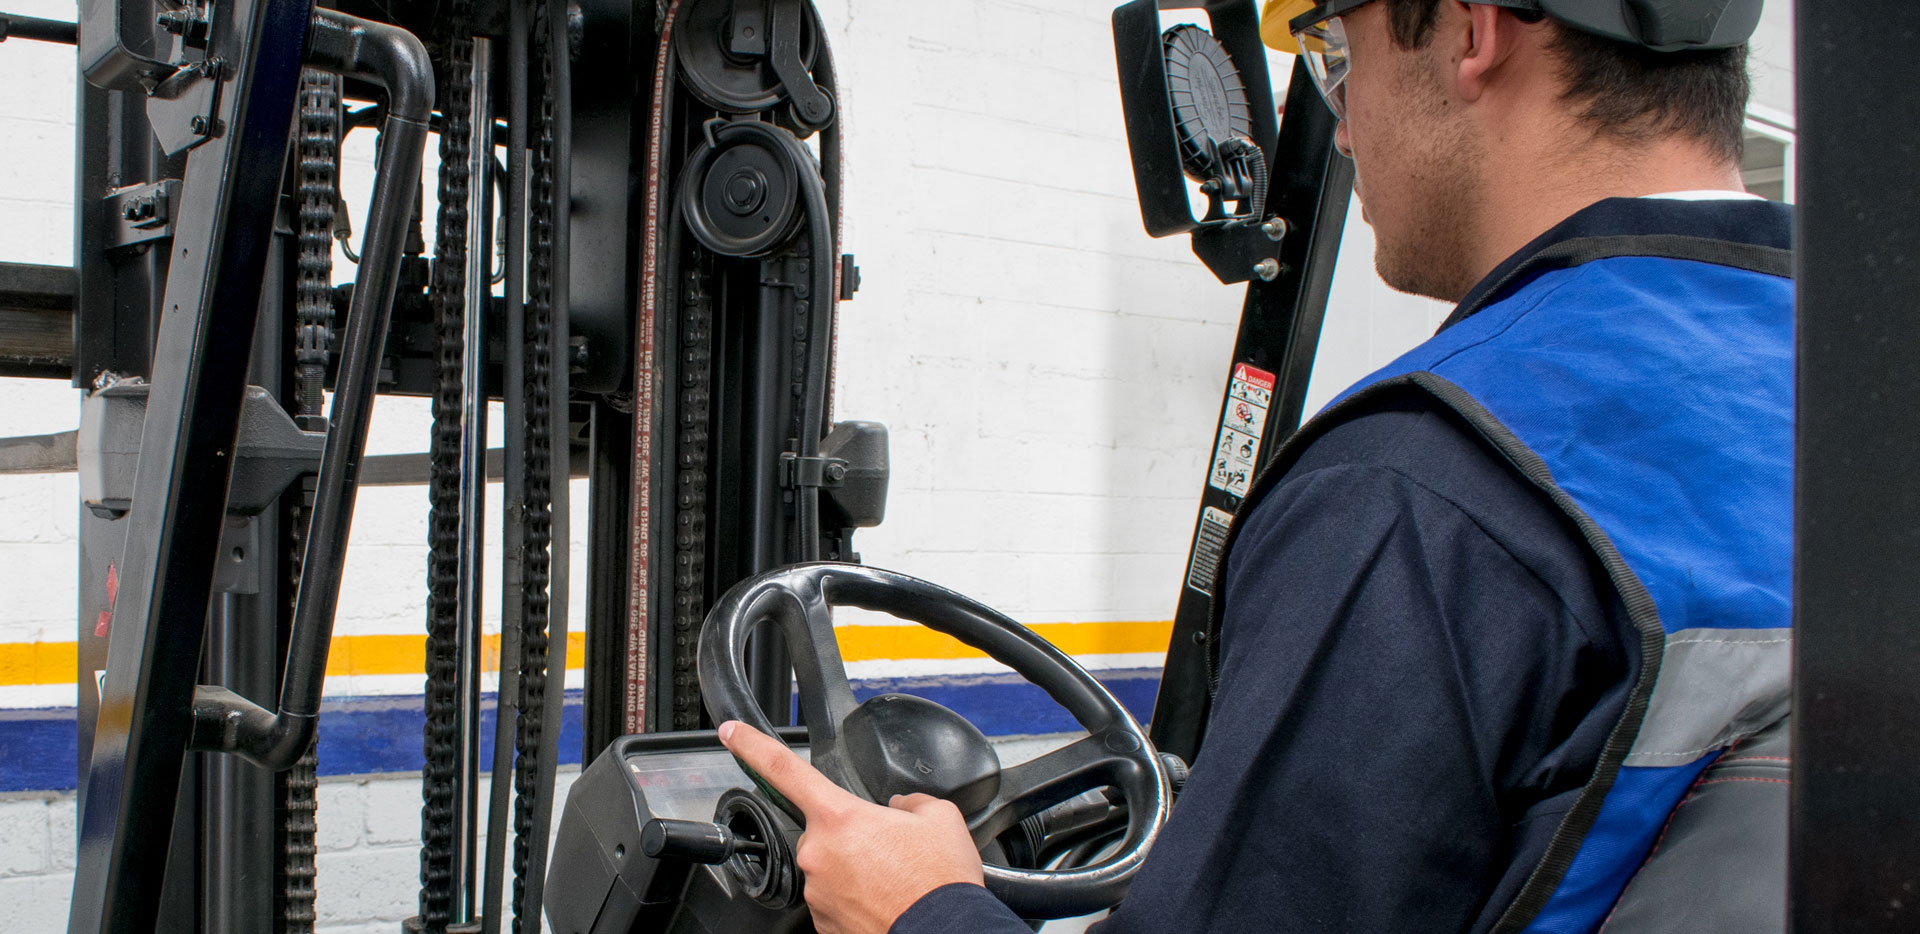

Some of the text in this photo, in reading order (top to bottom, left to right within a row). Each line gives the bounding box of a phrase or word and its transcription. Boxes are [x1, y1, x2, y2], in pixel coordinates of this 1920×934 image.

[654, 39, 668, 104] RESISTANT
[650, 108, 661, 168] ABRASION
[650, 173, 657, 181] &
[648, 185, 657, 216] FRAS
[647, 219, 656, 272] IC-227/12
[646, 275, 654, 310] MSHA
[644, 350, 652, 369] PSI
[1248, 375, 1272, 389] DANGER
[642, 436, 650, 456] 350
[642, 460, 649, 478] WP
[640, 510, 648, 539] DN10
[640, 543, 648, 560] -06
[630, 633, 638, 651] WP
[629, 654, 637, 680] MAX
[628, 683, 636, 712] DN10
[628, 716, 636, 733] -06
